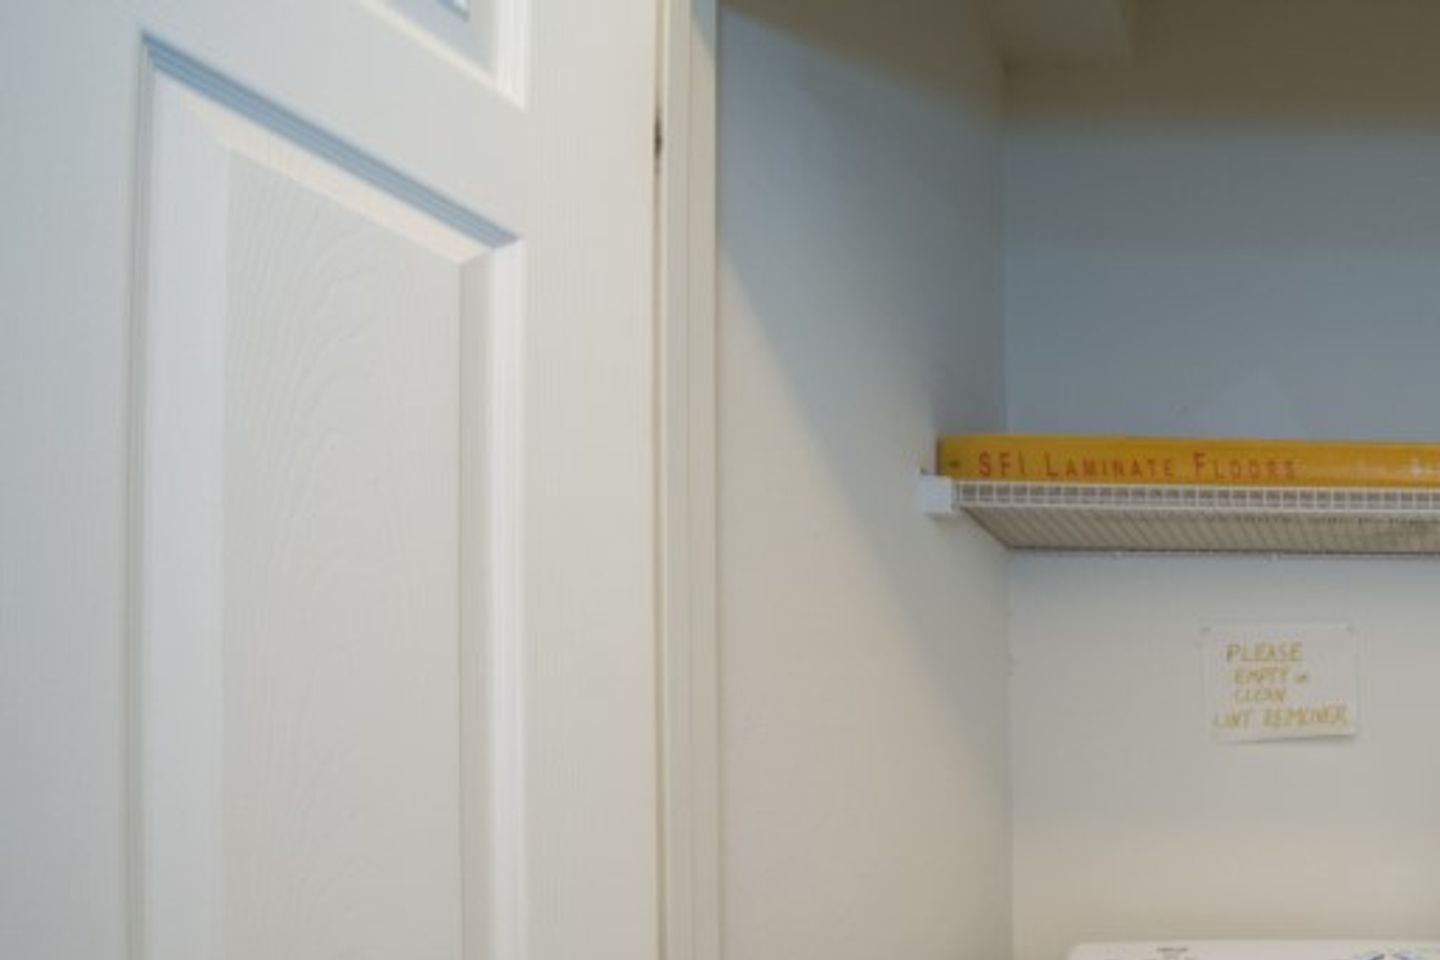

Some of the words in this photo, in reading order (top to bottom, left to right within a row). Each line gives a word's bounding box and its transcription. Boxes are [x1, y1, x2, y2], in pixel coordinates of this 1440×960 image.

[978, 450, 1026, 478] SFI
[1043, 451, 1173, 479] LAMINATE
[1192, 452, 1299, 480] FLOORS
[1225, 640, 1304, 663] PLEASE
[1234, 666, 1289, 685] EMPTY
[1234, 686, 1287, 704] CLEAN
